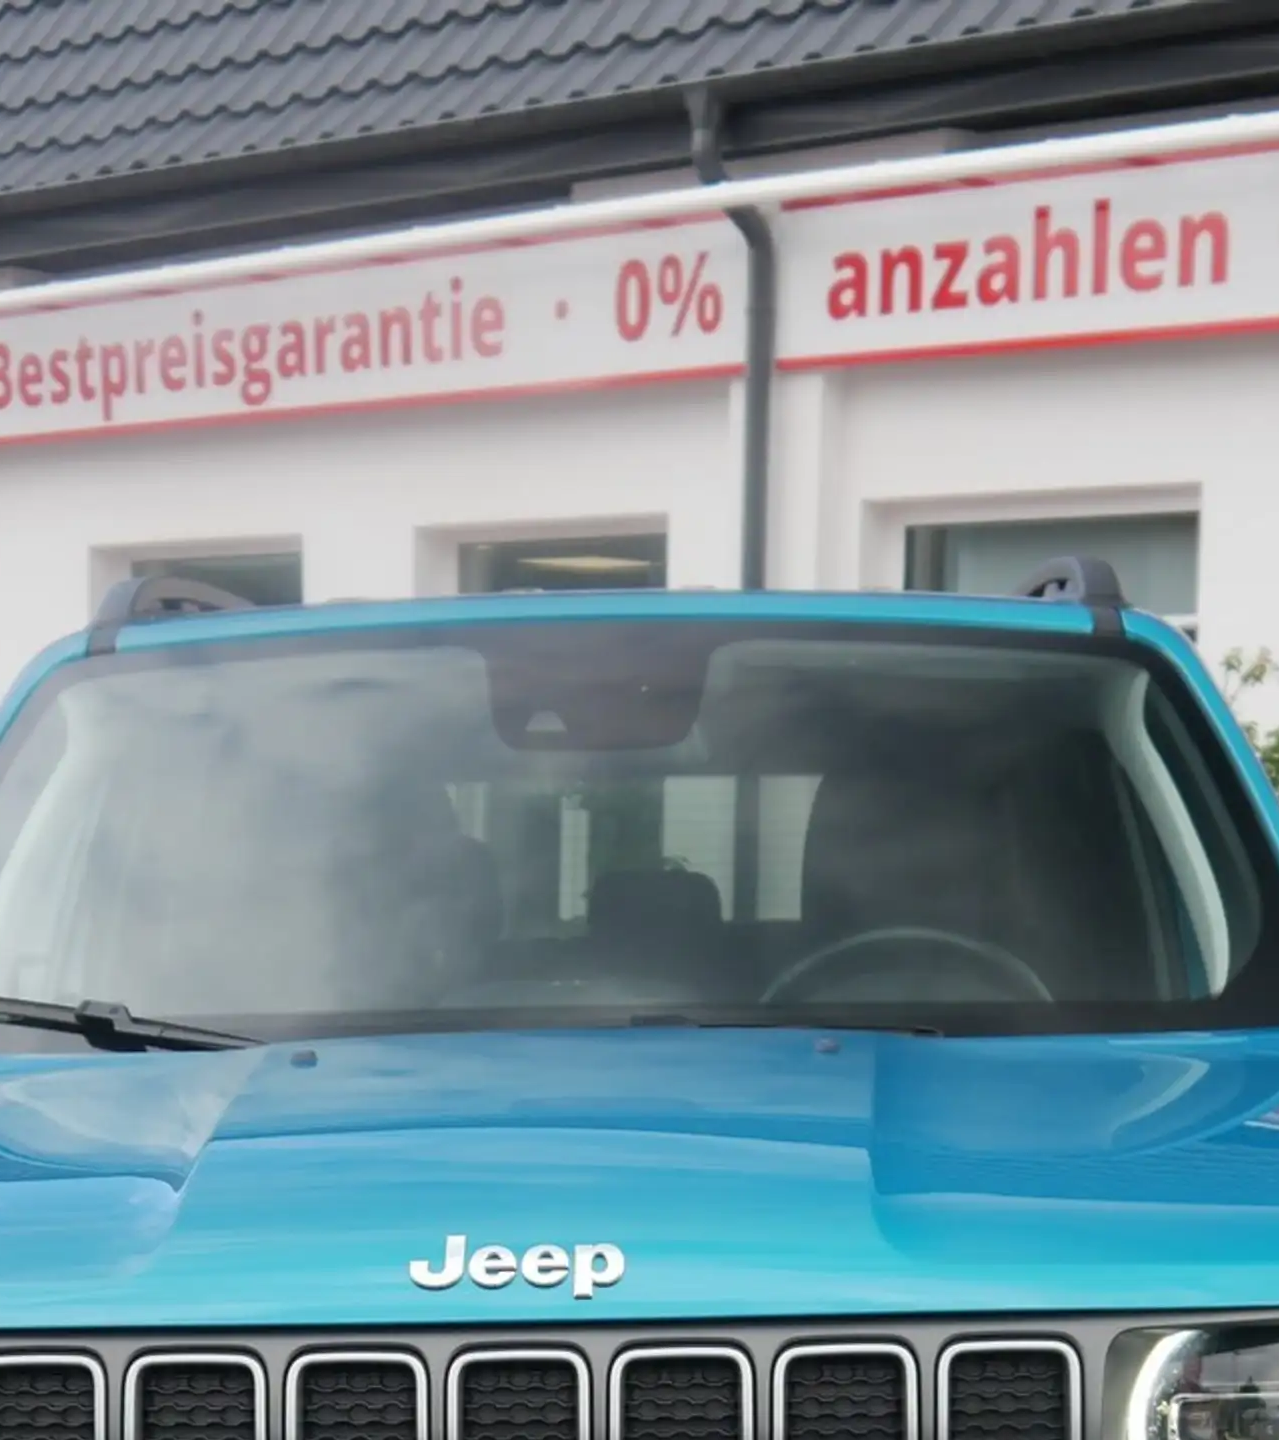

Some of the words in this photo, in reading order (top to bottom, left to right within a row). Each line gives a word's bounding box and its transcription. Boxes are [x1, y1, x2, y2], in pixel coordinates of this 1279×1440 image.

[613, 250, 724, 343] 0%
[824, 196, 1231, 322] anzahlen
[409, 1234, 625, 1300] Jeep
